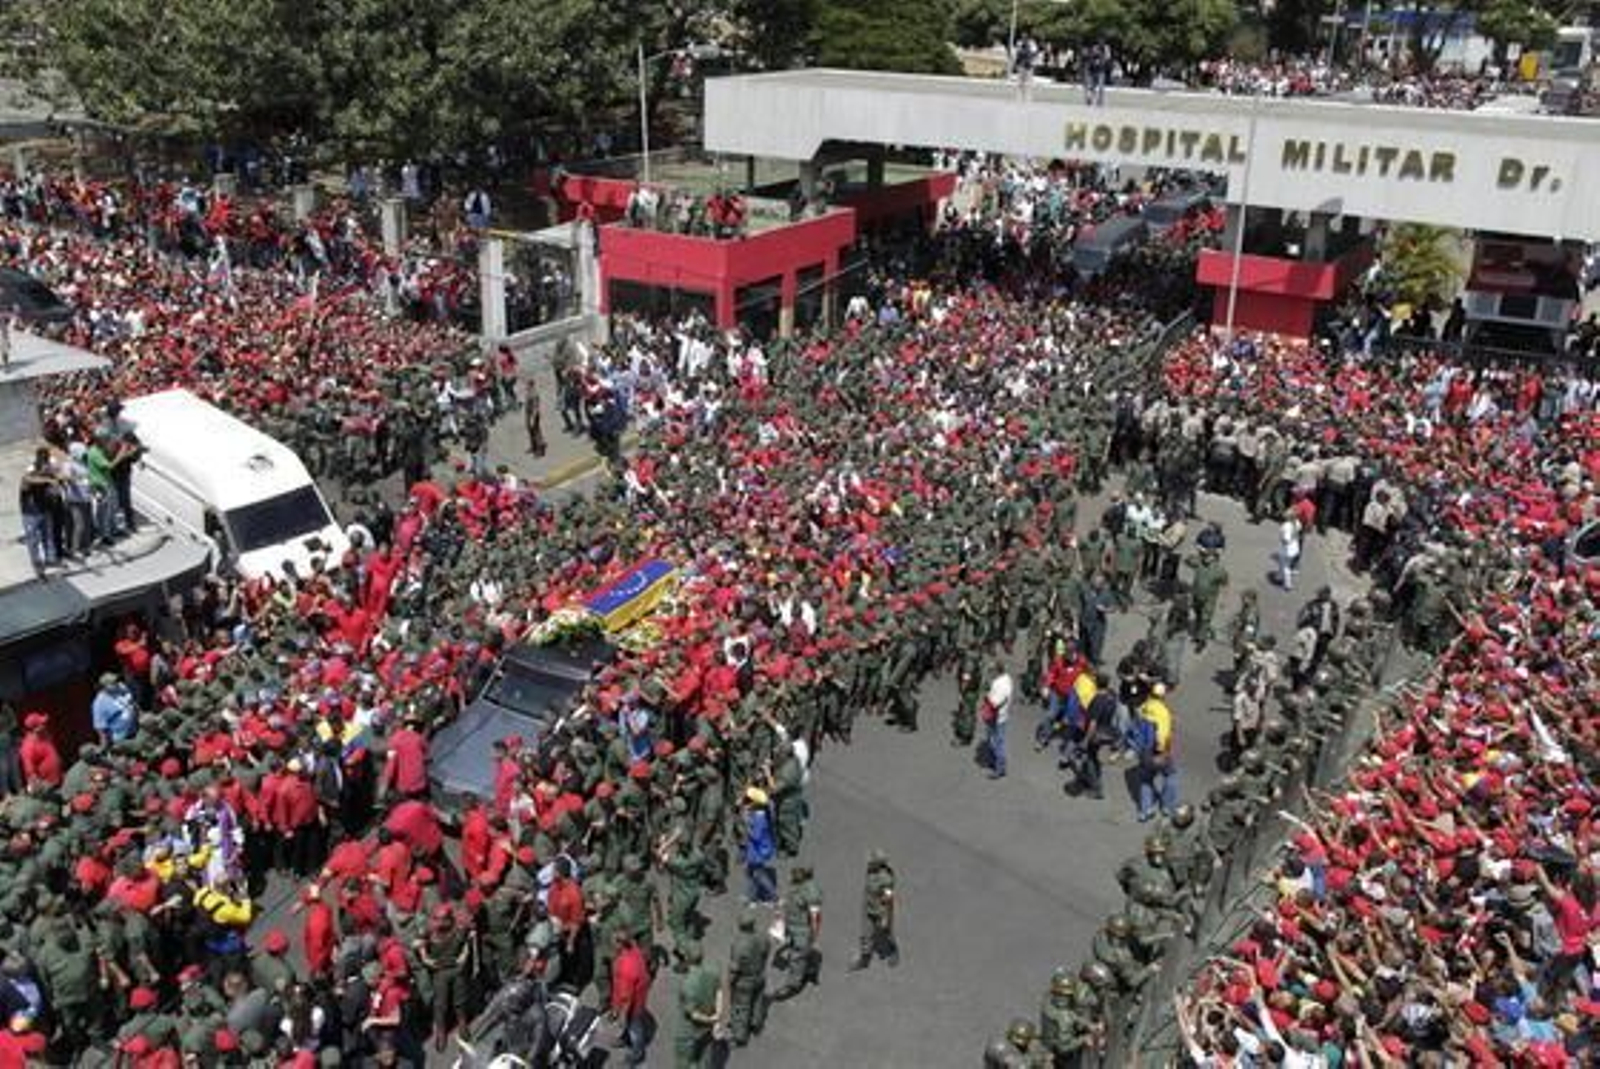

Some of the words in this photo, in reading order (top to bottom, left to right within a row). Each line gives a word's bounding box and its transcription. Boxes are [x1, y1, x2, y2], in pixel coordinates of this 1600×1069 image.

[1064, 121, 1246, 164] HOSPITAL
[1282, 140, 1455, 183] MILITAR
[1498, 158, 1562, 192] Dr.
